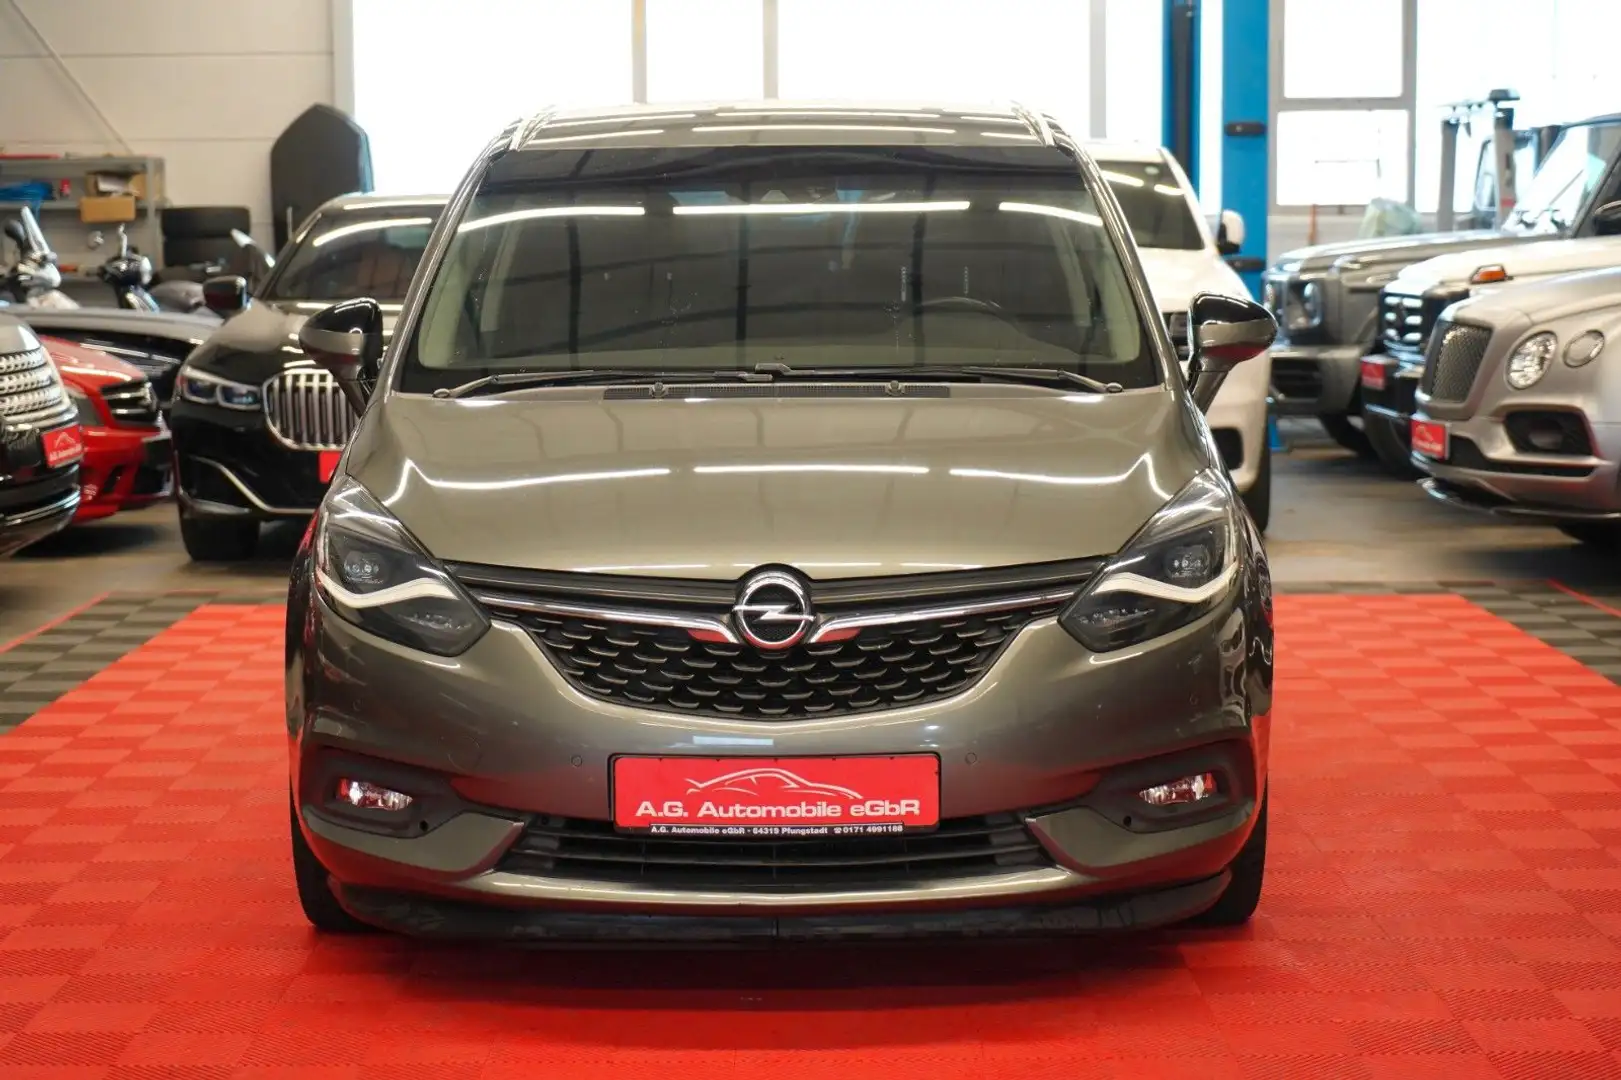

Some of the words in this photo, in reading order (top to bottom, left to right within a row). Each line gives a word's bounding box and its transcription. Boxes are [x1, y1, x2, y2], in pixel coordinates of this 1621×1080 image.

[634, 800, 689, 818] A.G.
[696, 800, 842, 818] Automobile
[849, 799, 920, 817] eGbR
[651, 826, 669, 834] A.G.
[671, 826, 720, 834] Automobile
[722, 826, 745, 835] eGbR
[781, 826, 828, 836] Pfungstadt
[842, 826, 864, 834] 0171
